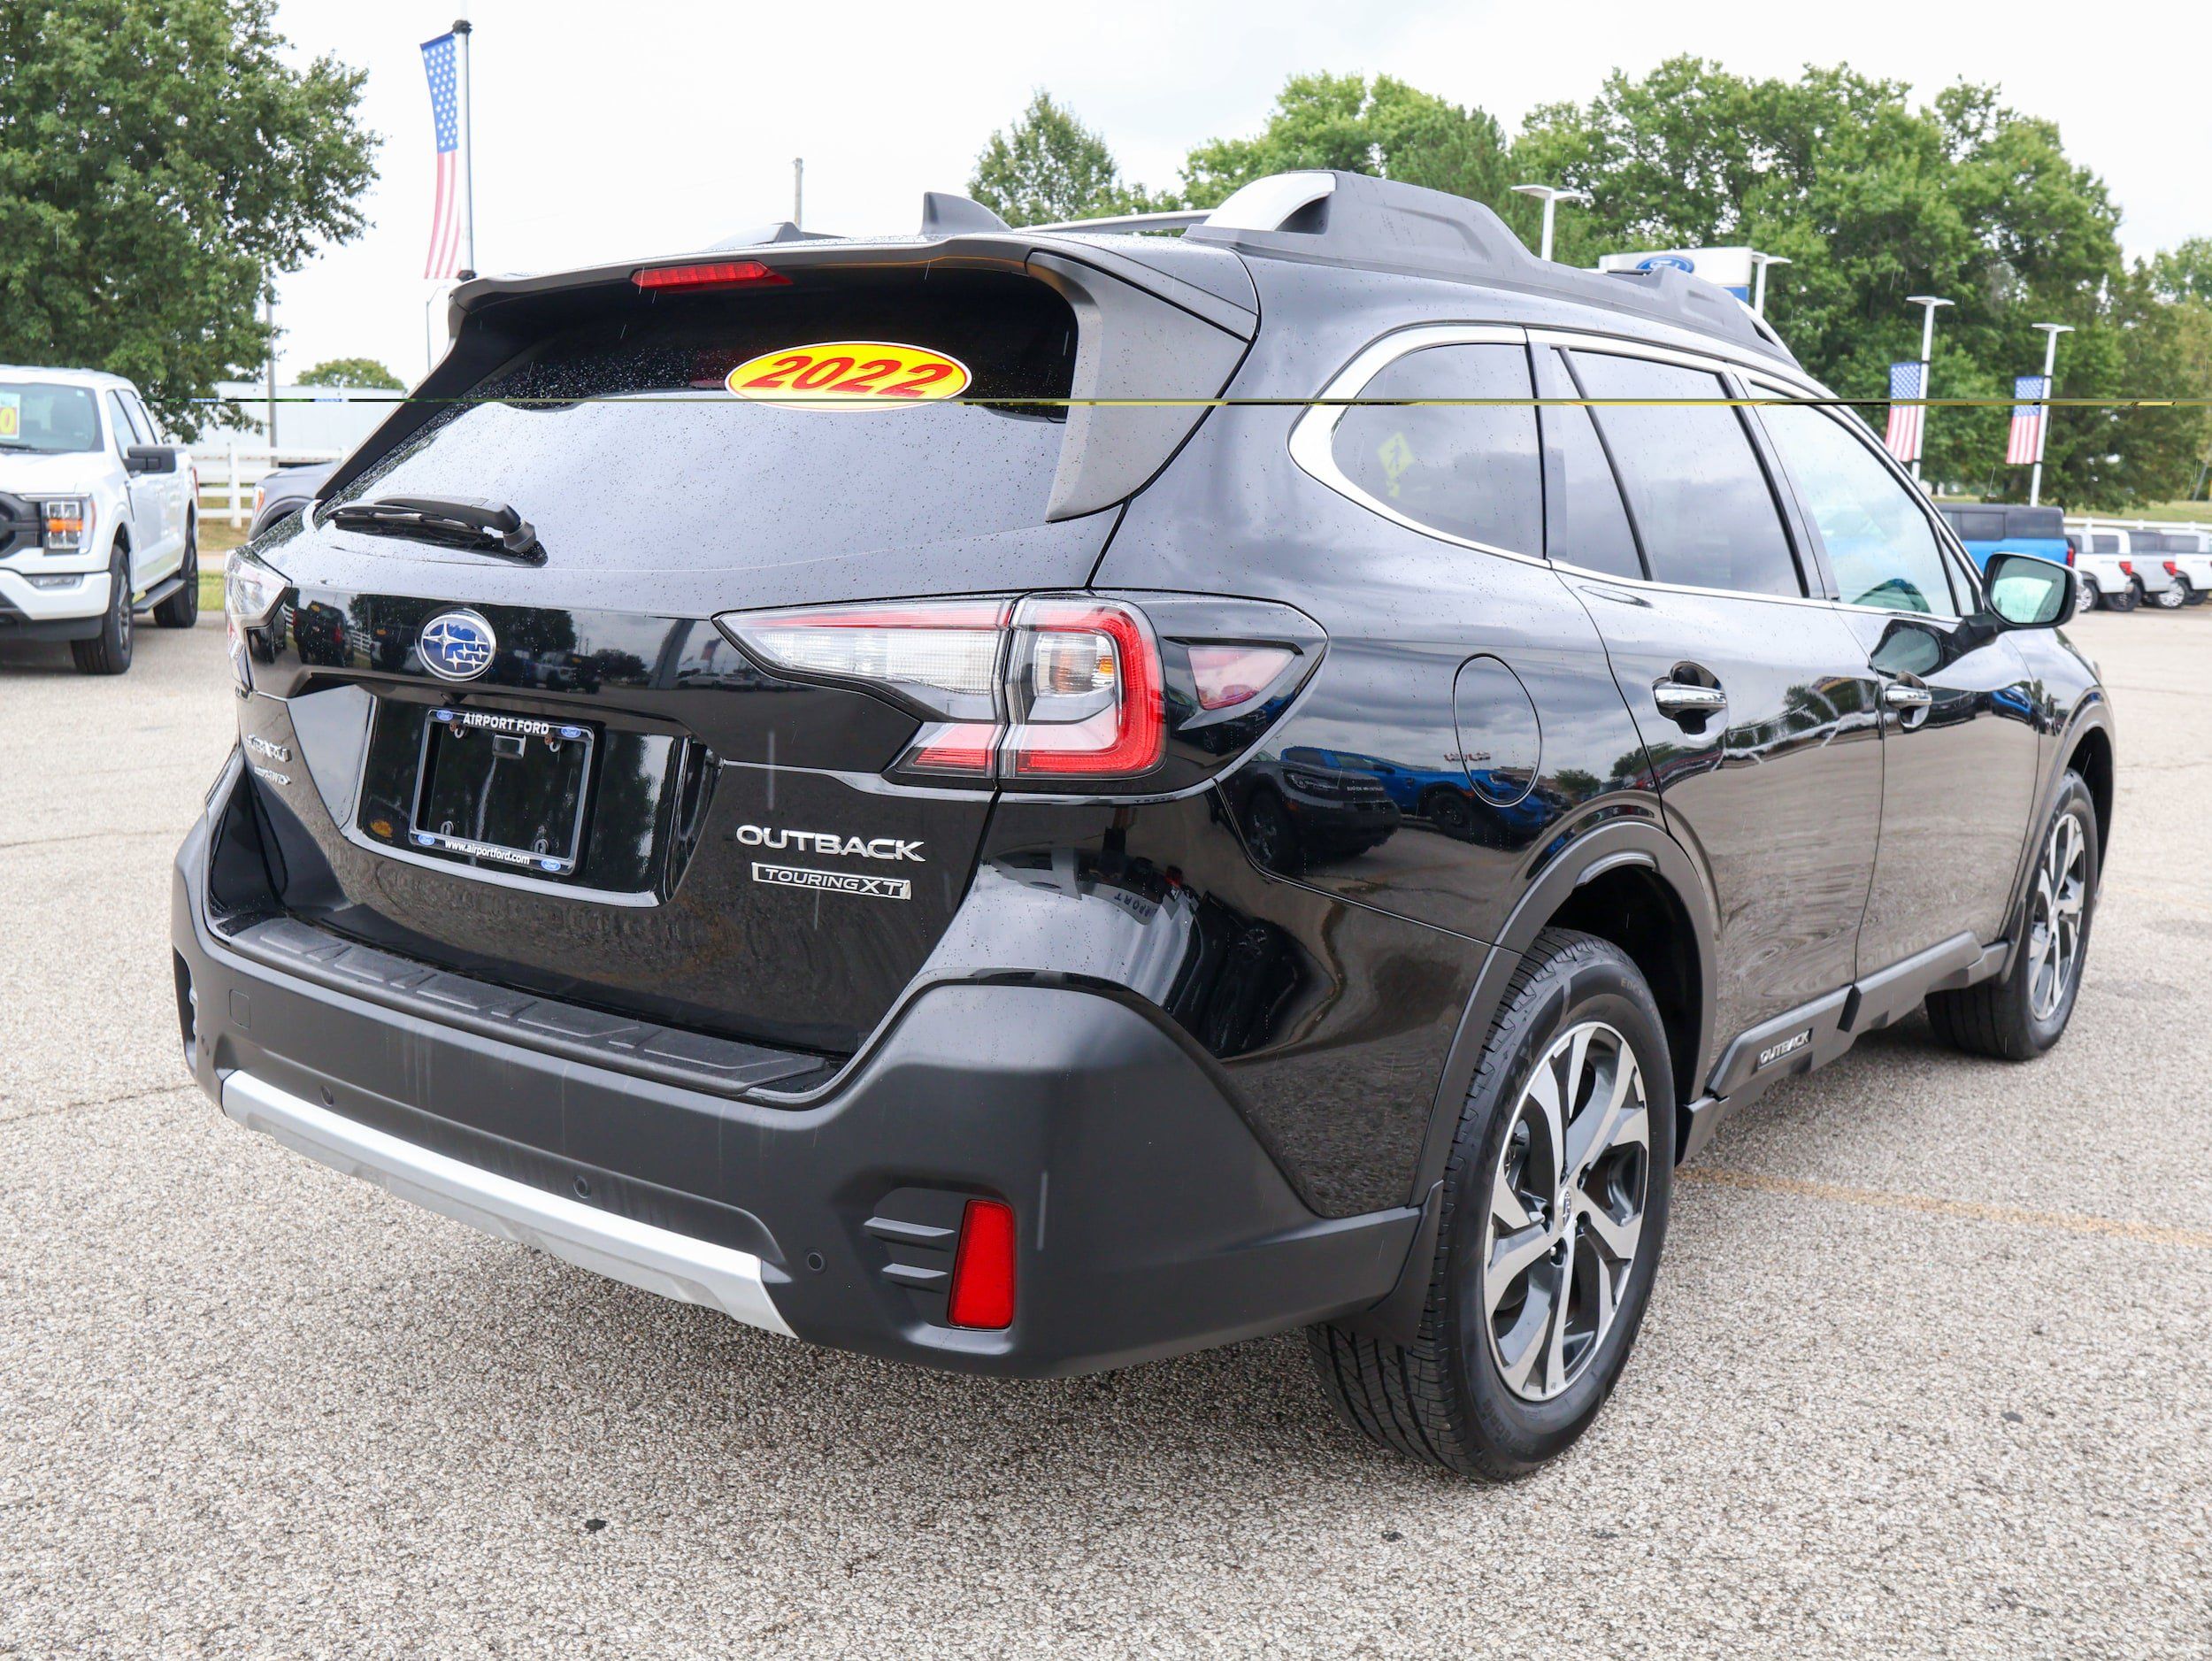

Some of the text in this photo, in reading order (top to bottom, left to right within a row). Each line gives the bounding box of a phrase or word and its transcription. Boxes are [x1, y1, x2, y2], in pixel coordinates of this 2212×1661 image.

[741, 355, 953, 398] 2022
[463, 711, 513, 731] AIRPORT
[516, 719, 549, 735] FORD
[444, 839, 531, 865] www.airportford.com
[736, 824, 926, 862] OUTBACK
[1760, 1030, 1809, 1065] OUTBACK
